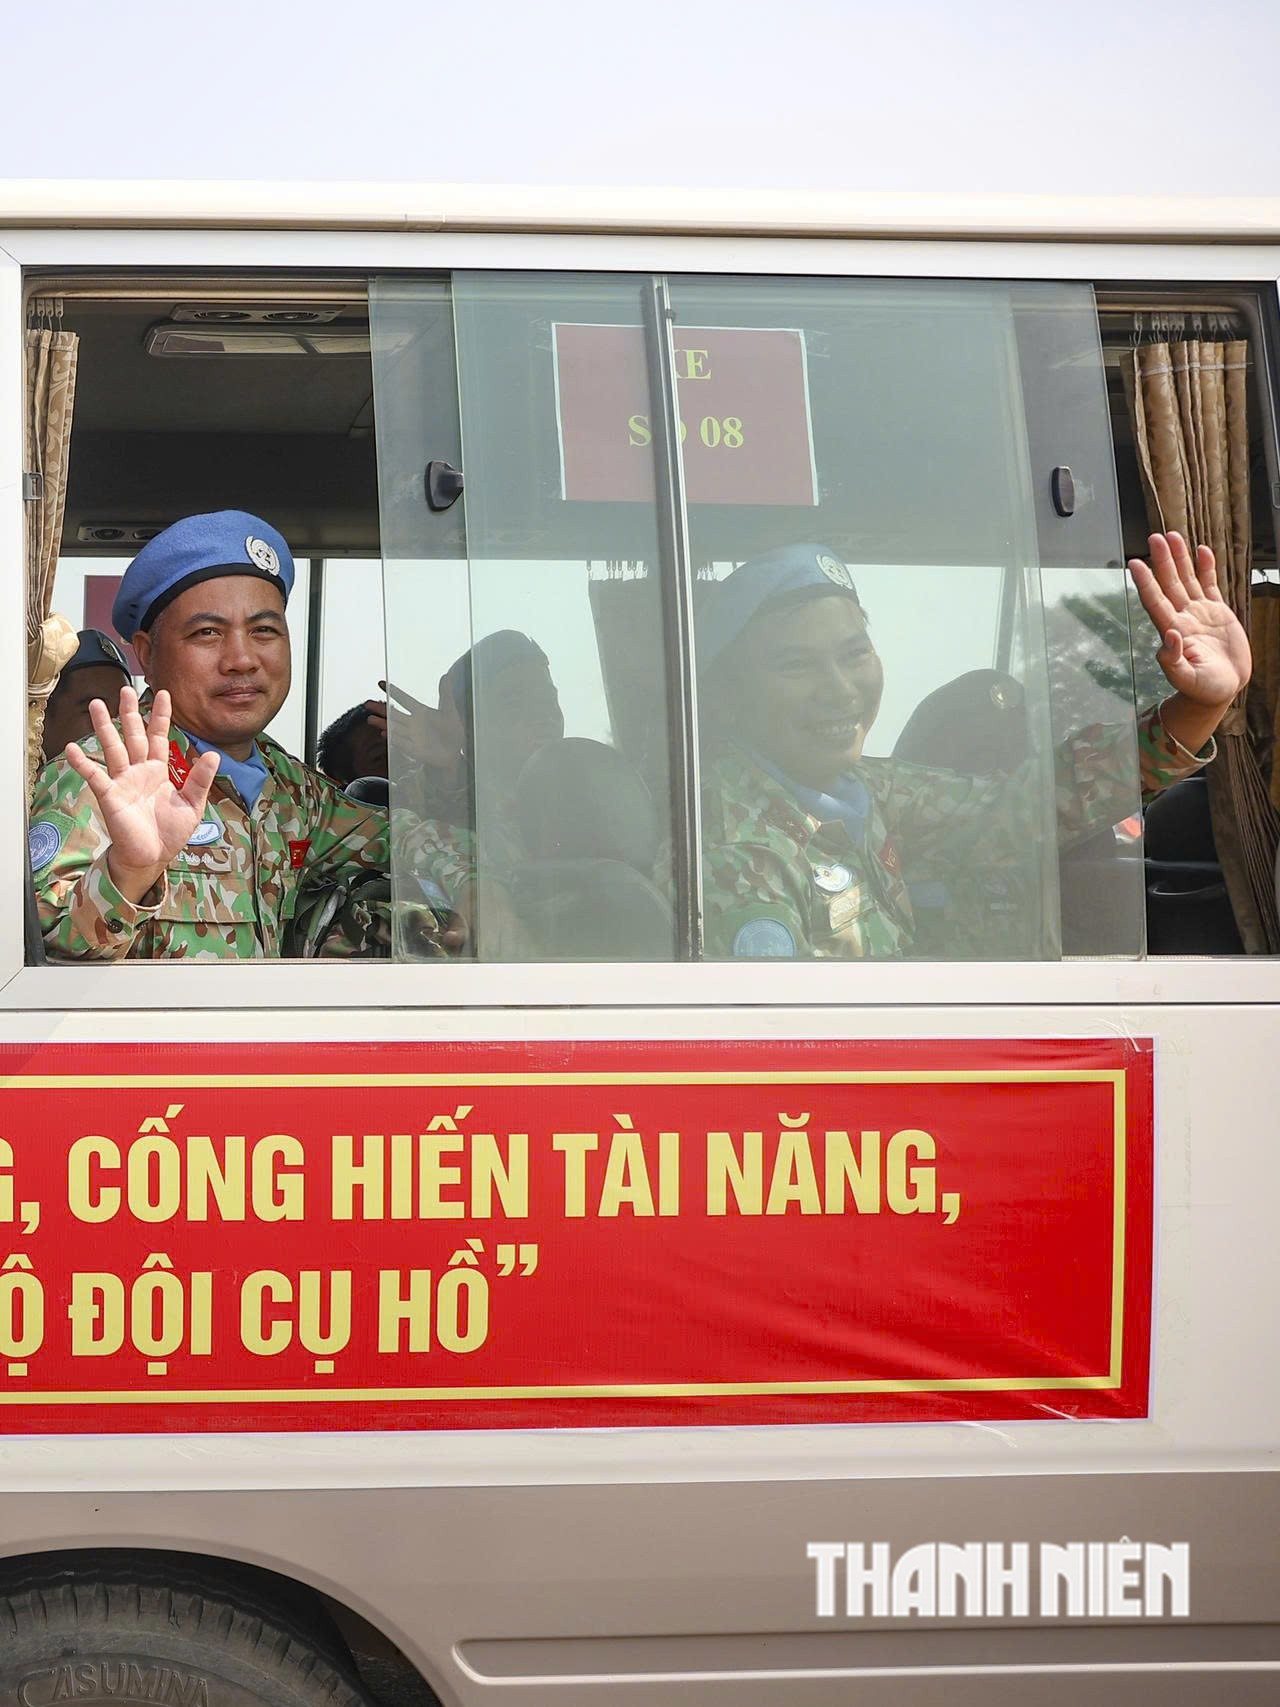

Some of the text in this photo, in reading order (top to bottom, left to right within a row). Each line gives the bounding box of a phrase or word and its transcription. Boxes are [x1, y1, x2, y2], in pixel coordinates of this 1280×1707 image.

[628, 415, 744, 448] S 08
[68, 1103, 305, 1224] CỐNG
[331, 1105, 529, 1220] HIẾN
[552, 1113, 680, 1218] TÀI
[706, 1112, 961, 1225] NĂNG,
[67, 1252, 213, 1376] ĐỘI
[240, 1269, 352, 1374] CỤ
